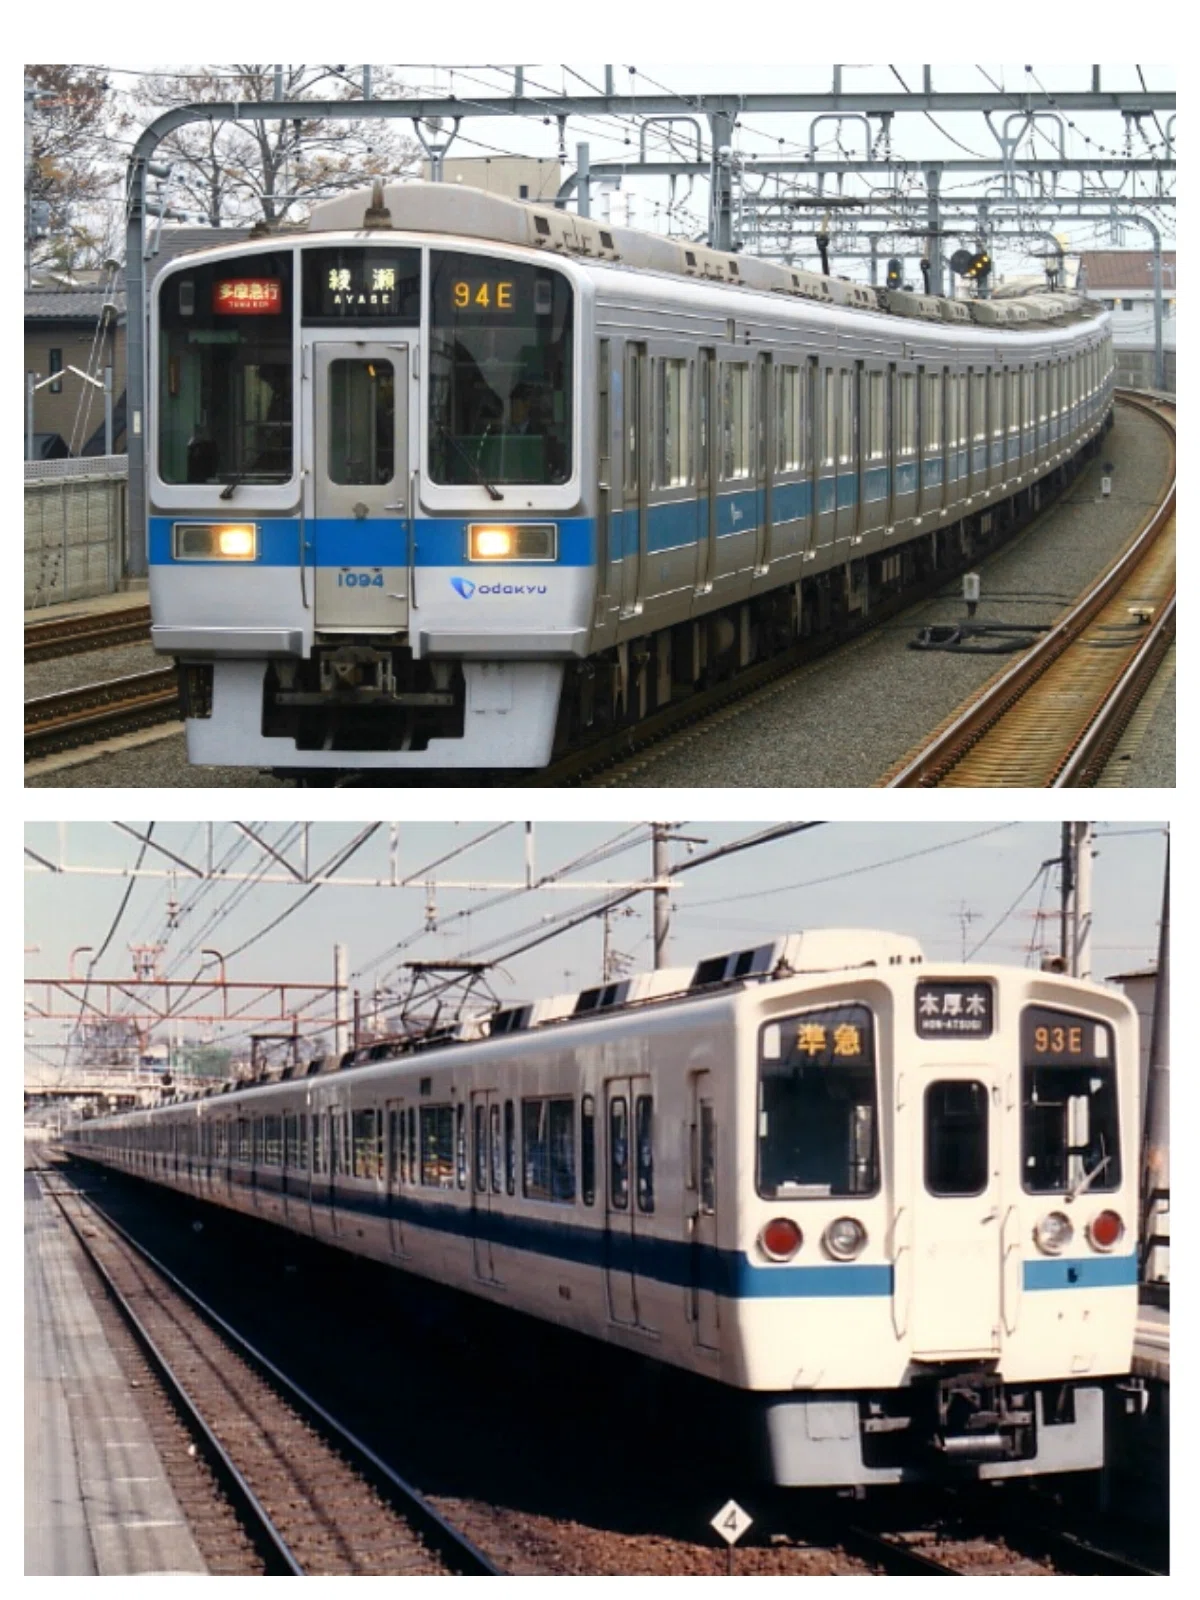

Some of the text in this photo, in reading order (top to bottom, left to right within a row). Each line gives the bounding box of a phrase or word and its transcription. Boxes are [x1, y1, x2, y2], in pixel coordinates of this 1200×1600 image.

[328, 268, 395, 291] 綾瀬
[219, 283, 279, 300] 多摩急行
[334, 294, 391, 304] AYASE
[454, 281, 513, 308] 94E
[337, 573, 385, 588] 1094
[919, 992, 986, 1016] 本厚木
[797, 1023, 861, 1056] 準急
[1035, 1027, 1081, 1052] 93E
[723, 1509, 737, 1531] 4
